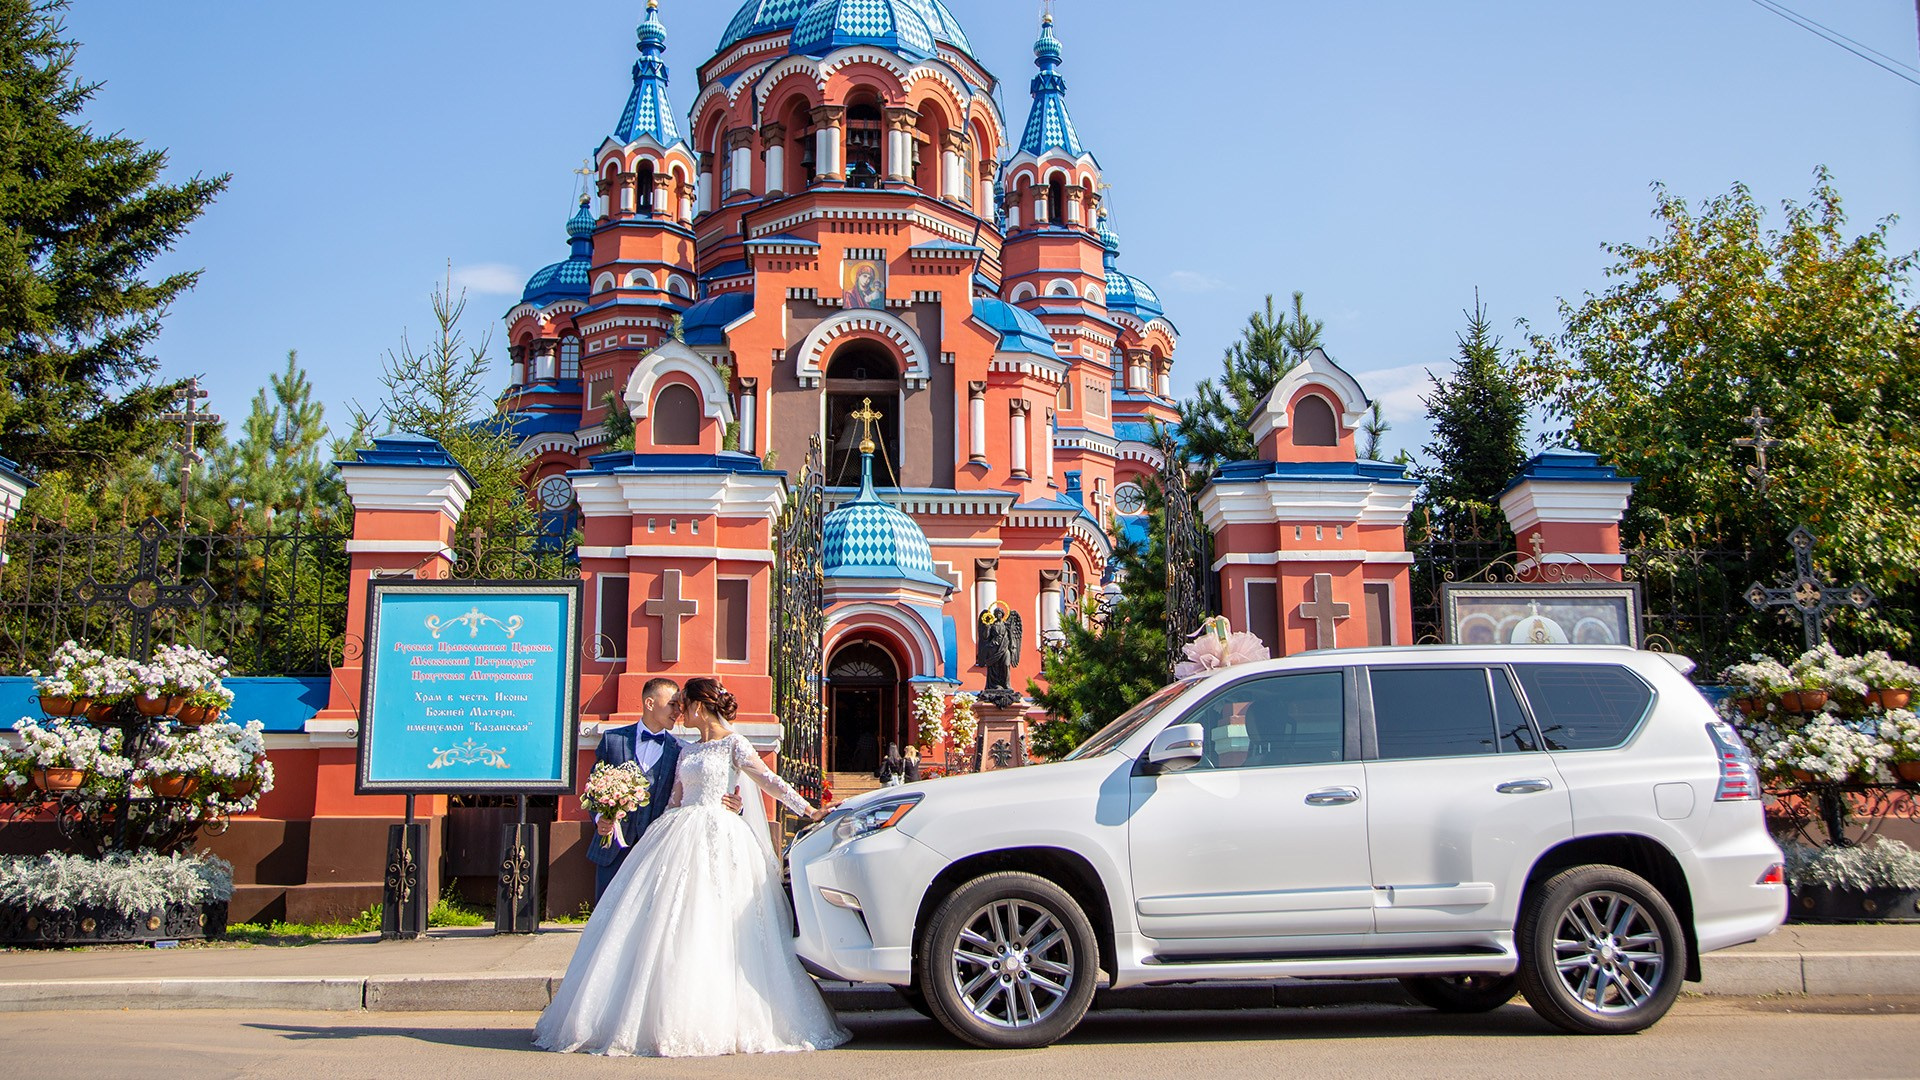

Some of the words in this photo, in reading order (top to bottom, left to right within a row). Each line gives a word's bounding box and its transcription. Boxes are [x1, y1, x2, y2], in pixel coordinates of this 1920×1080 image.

[394, 642, 433, 654] Русская
[438, 642, 507, 654] Православная
[512, 642, 554, 654] Церковь
[410, 656, 470, 666] Московский
[475, 656, 536, 668] Патриархат
[412, 670, 465, 683] Иркутская
[470, 670, 533, 683] Митрополия
[415, 692, 442, 703] Храм
[495, 692, 528, 701] Иконы
[426, 707, 464, 716] Божией
[407, 723, 464, 734] именуемой
[470, 721, 533, 731] "Казанская"
